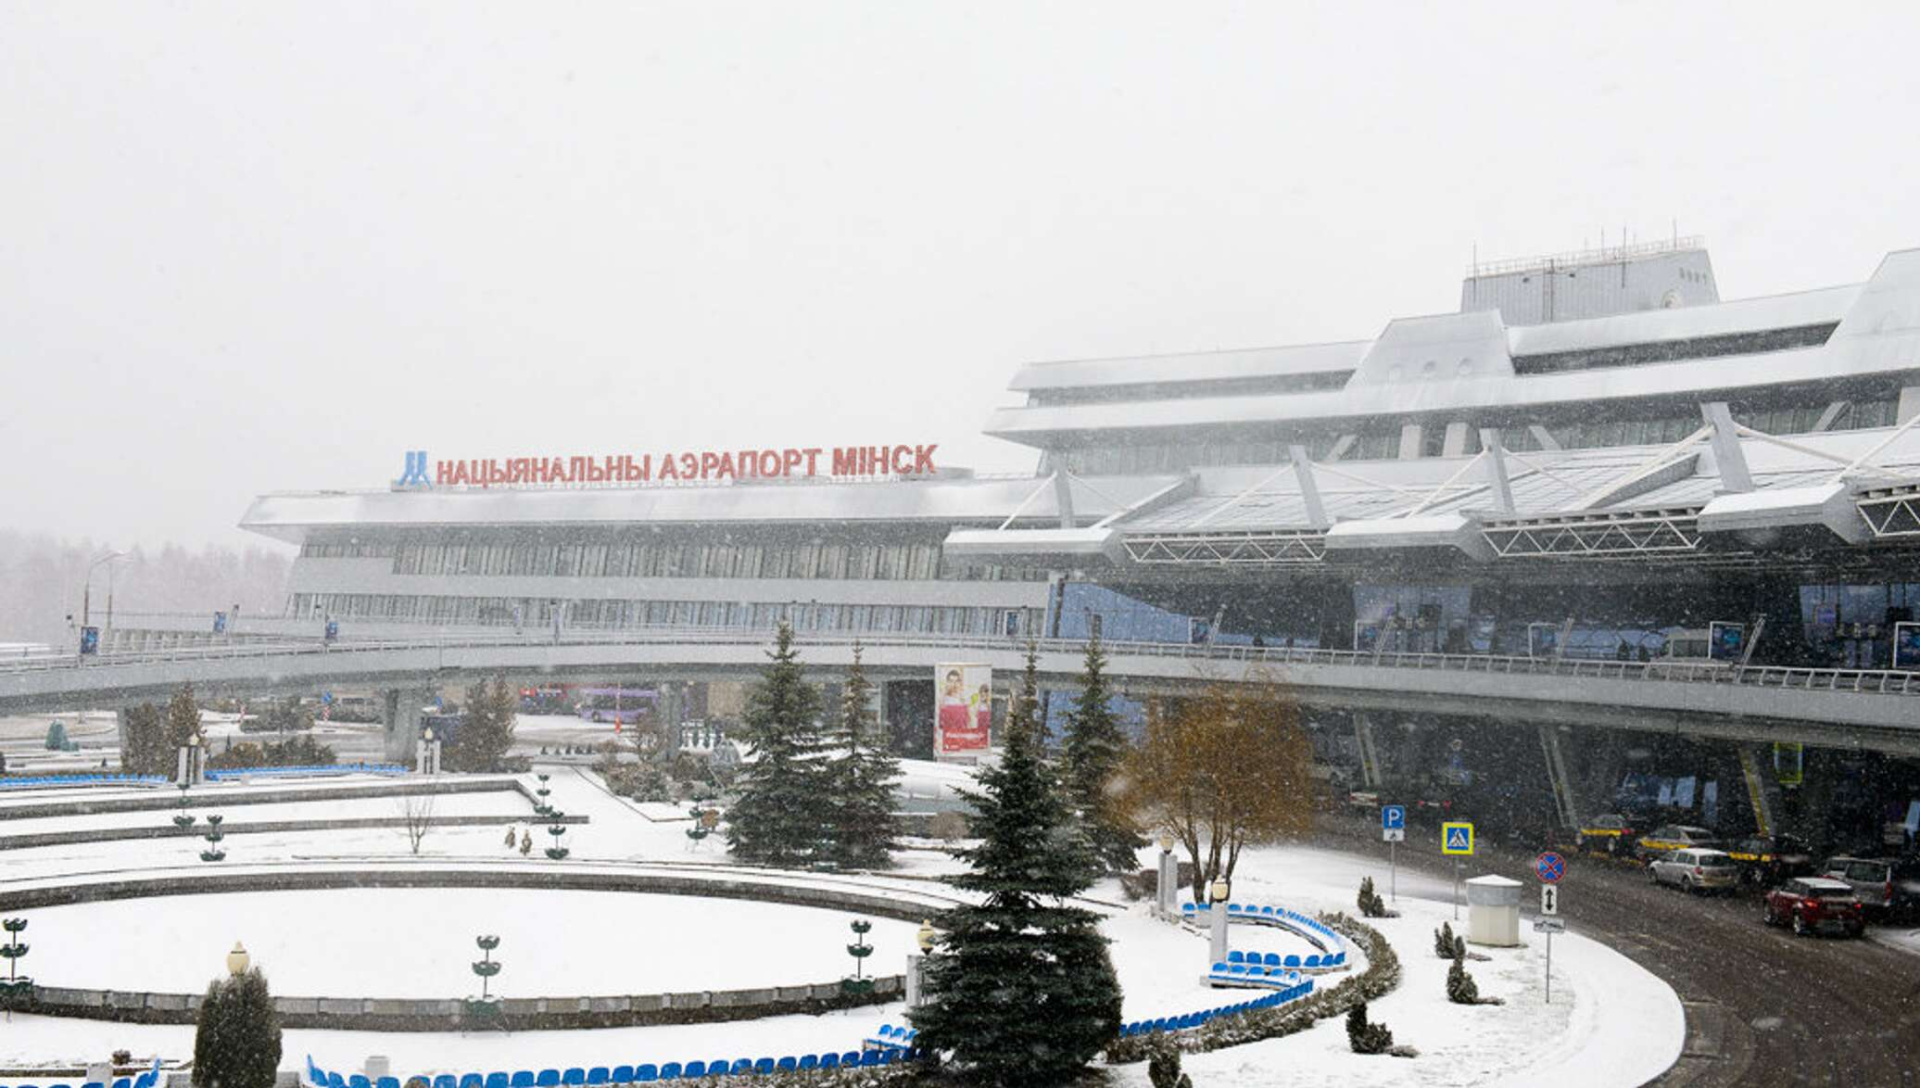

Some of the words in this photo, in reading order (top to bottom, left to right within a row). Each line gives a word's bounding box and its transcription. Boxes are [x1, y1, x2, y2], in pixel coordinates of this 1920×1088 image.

[436, 454, 651, 488] НАЦЫЯНАЛЬНЫ
[658, 447, 823, 481] АЭРАПОРТ
[831, 444, 938, 476] МІНСК
[1388, 809, 1401, 827] P
